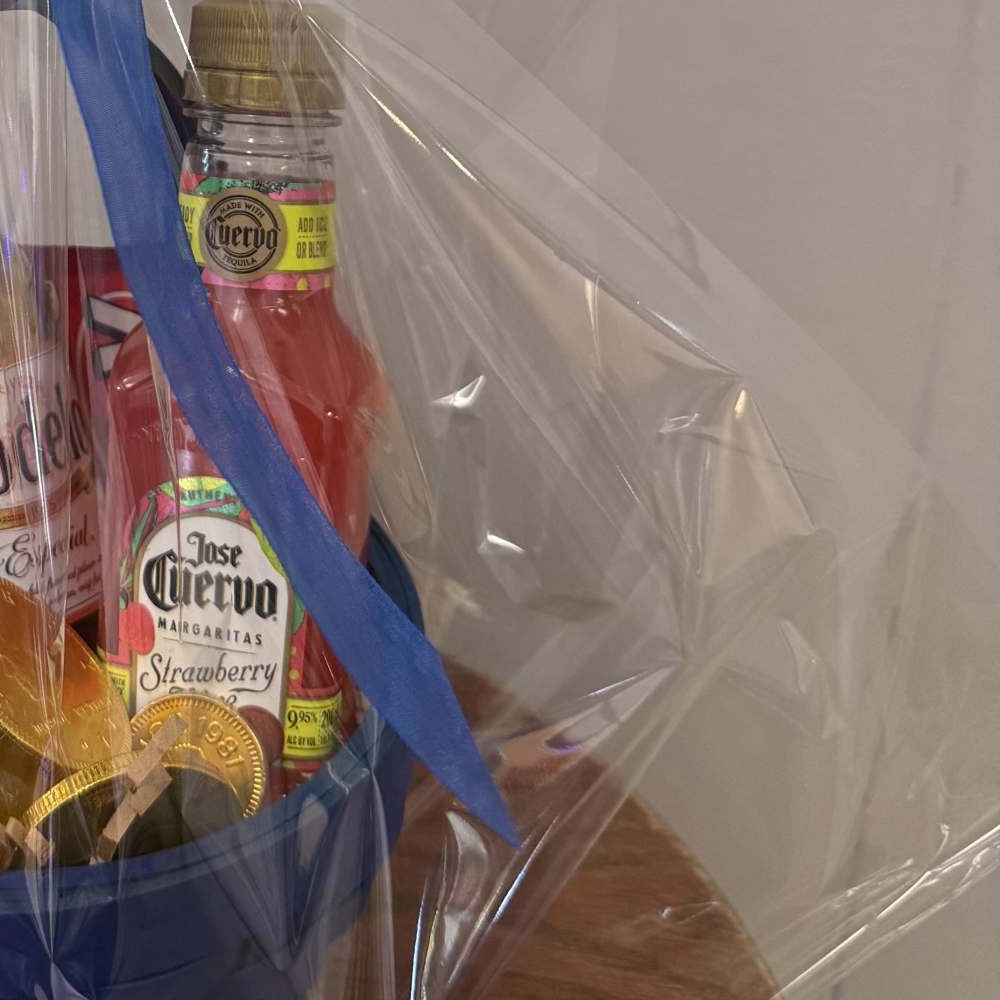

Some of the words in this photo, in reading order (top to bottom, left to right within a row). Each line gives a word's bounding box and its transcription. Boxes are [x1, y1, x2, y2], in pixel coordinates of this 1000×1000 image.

[219, 201, 242, 215] MADE
[244, 201, 265, 218] WITH
[298, 217, 313, 233] ADD
[205, 214, 281, 250] Cuervo
[222, 253, 258, 267] TEQUILA
[296, 242, 307, 259] OR
[308, 241, 328, 258] BLEND
[184, 531, 243, 566] Jose
[143, 549, 278, 620] Cuervo
[157, 616, 263, 646] MARGARITAS
[139, 651, 279, 693] Strawberry
[200, 715, 245, 768] 1981
